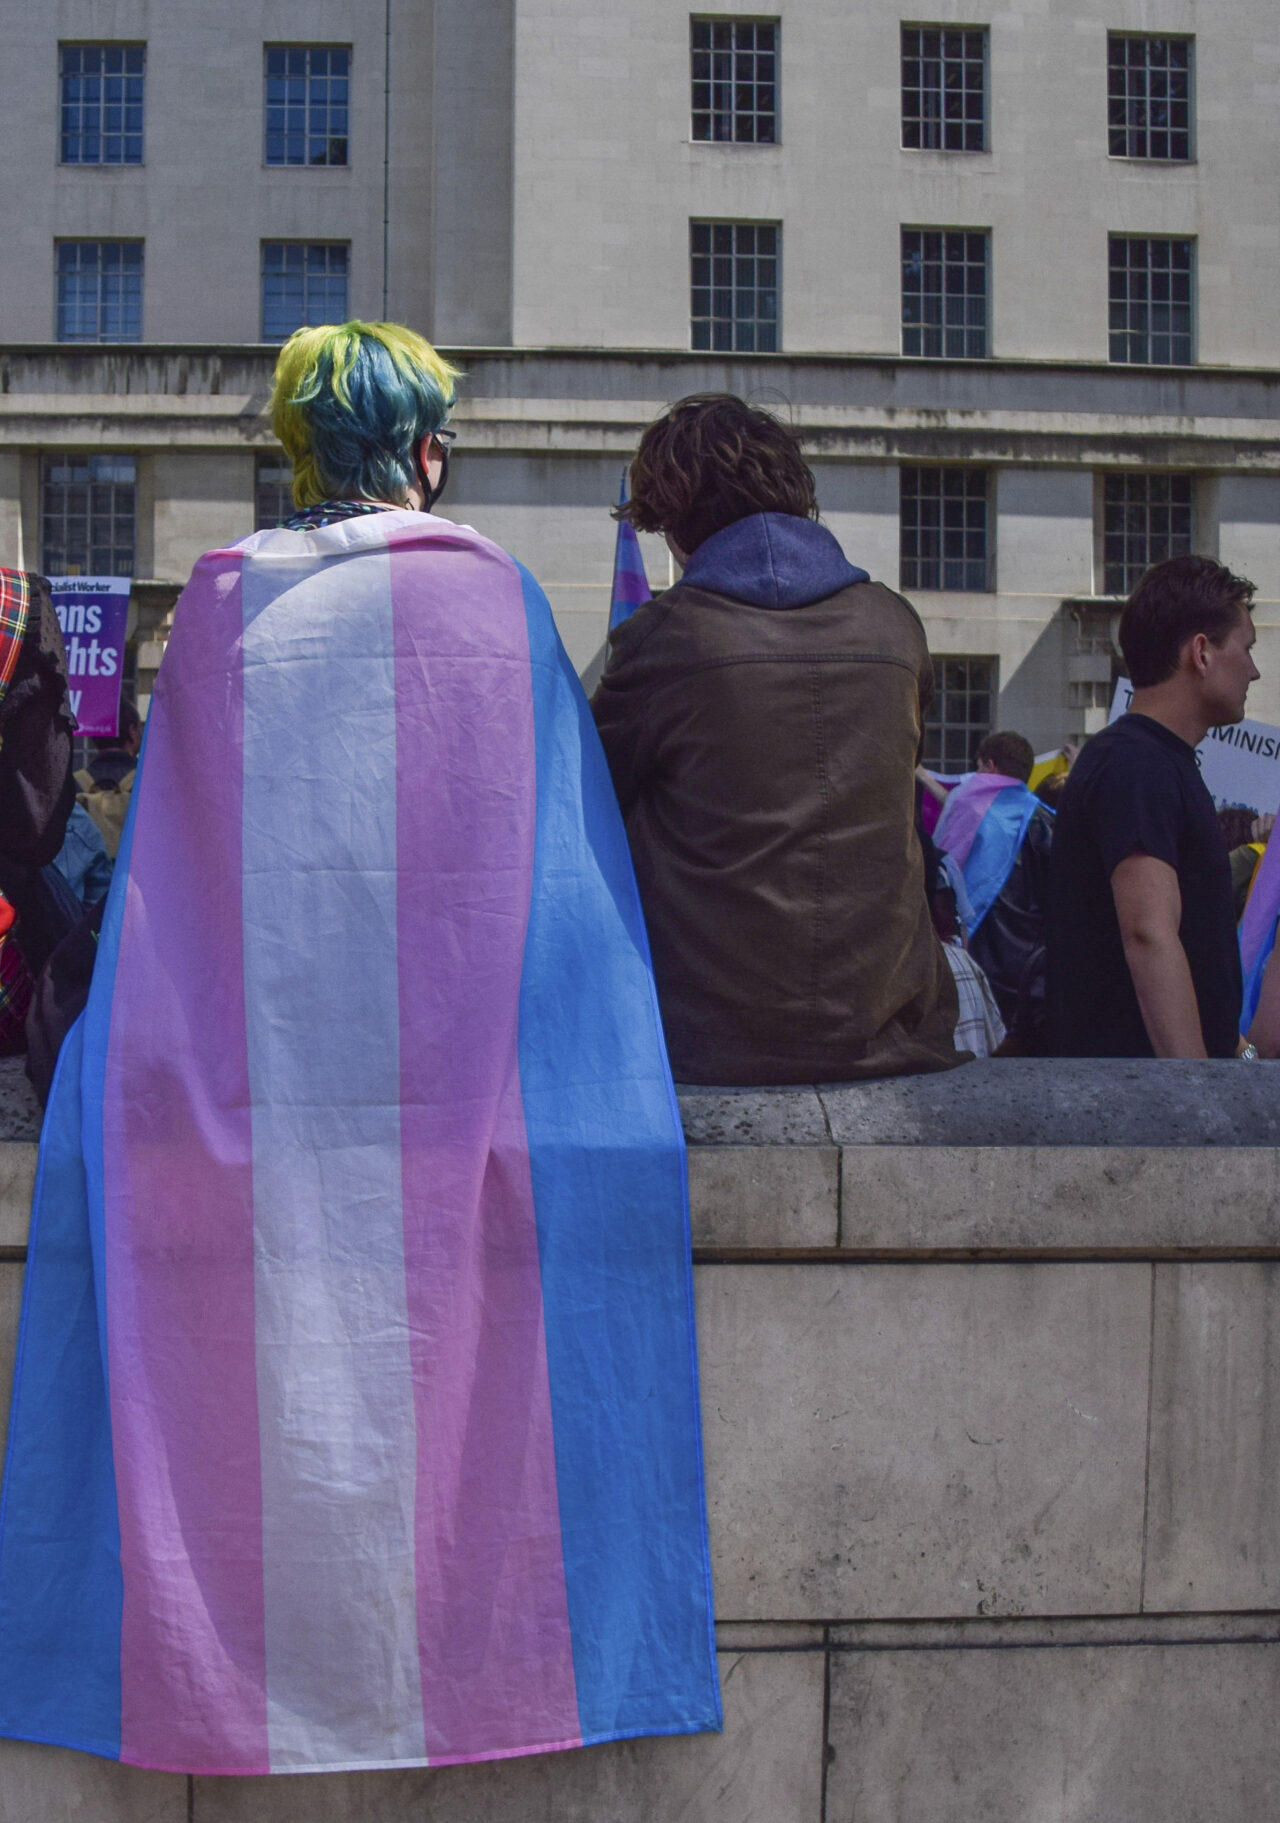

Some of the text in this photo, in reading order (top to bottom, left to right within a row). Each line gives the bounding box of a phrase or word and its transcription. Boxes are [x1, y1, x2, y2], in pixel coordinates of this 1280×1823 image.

[52, 582, 111, 592] cialist Worker
[55, 605, 102, 633] ans
[65, 636, 118, 676] hts
[1207, 725, 1280, 760] MINIS
